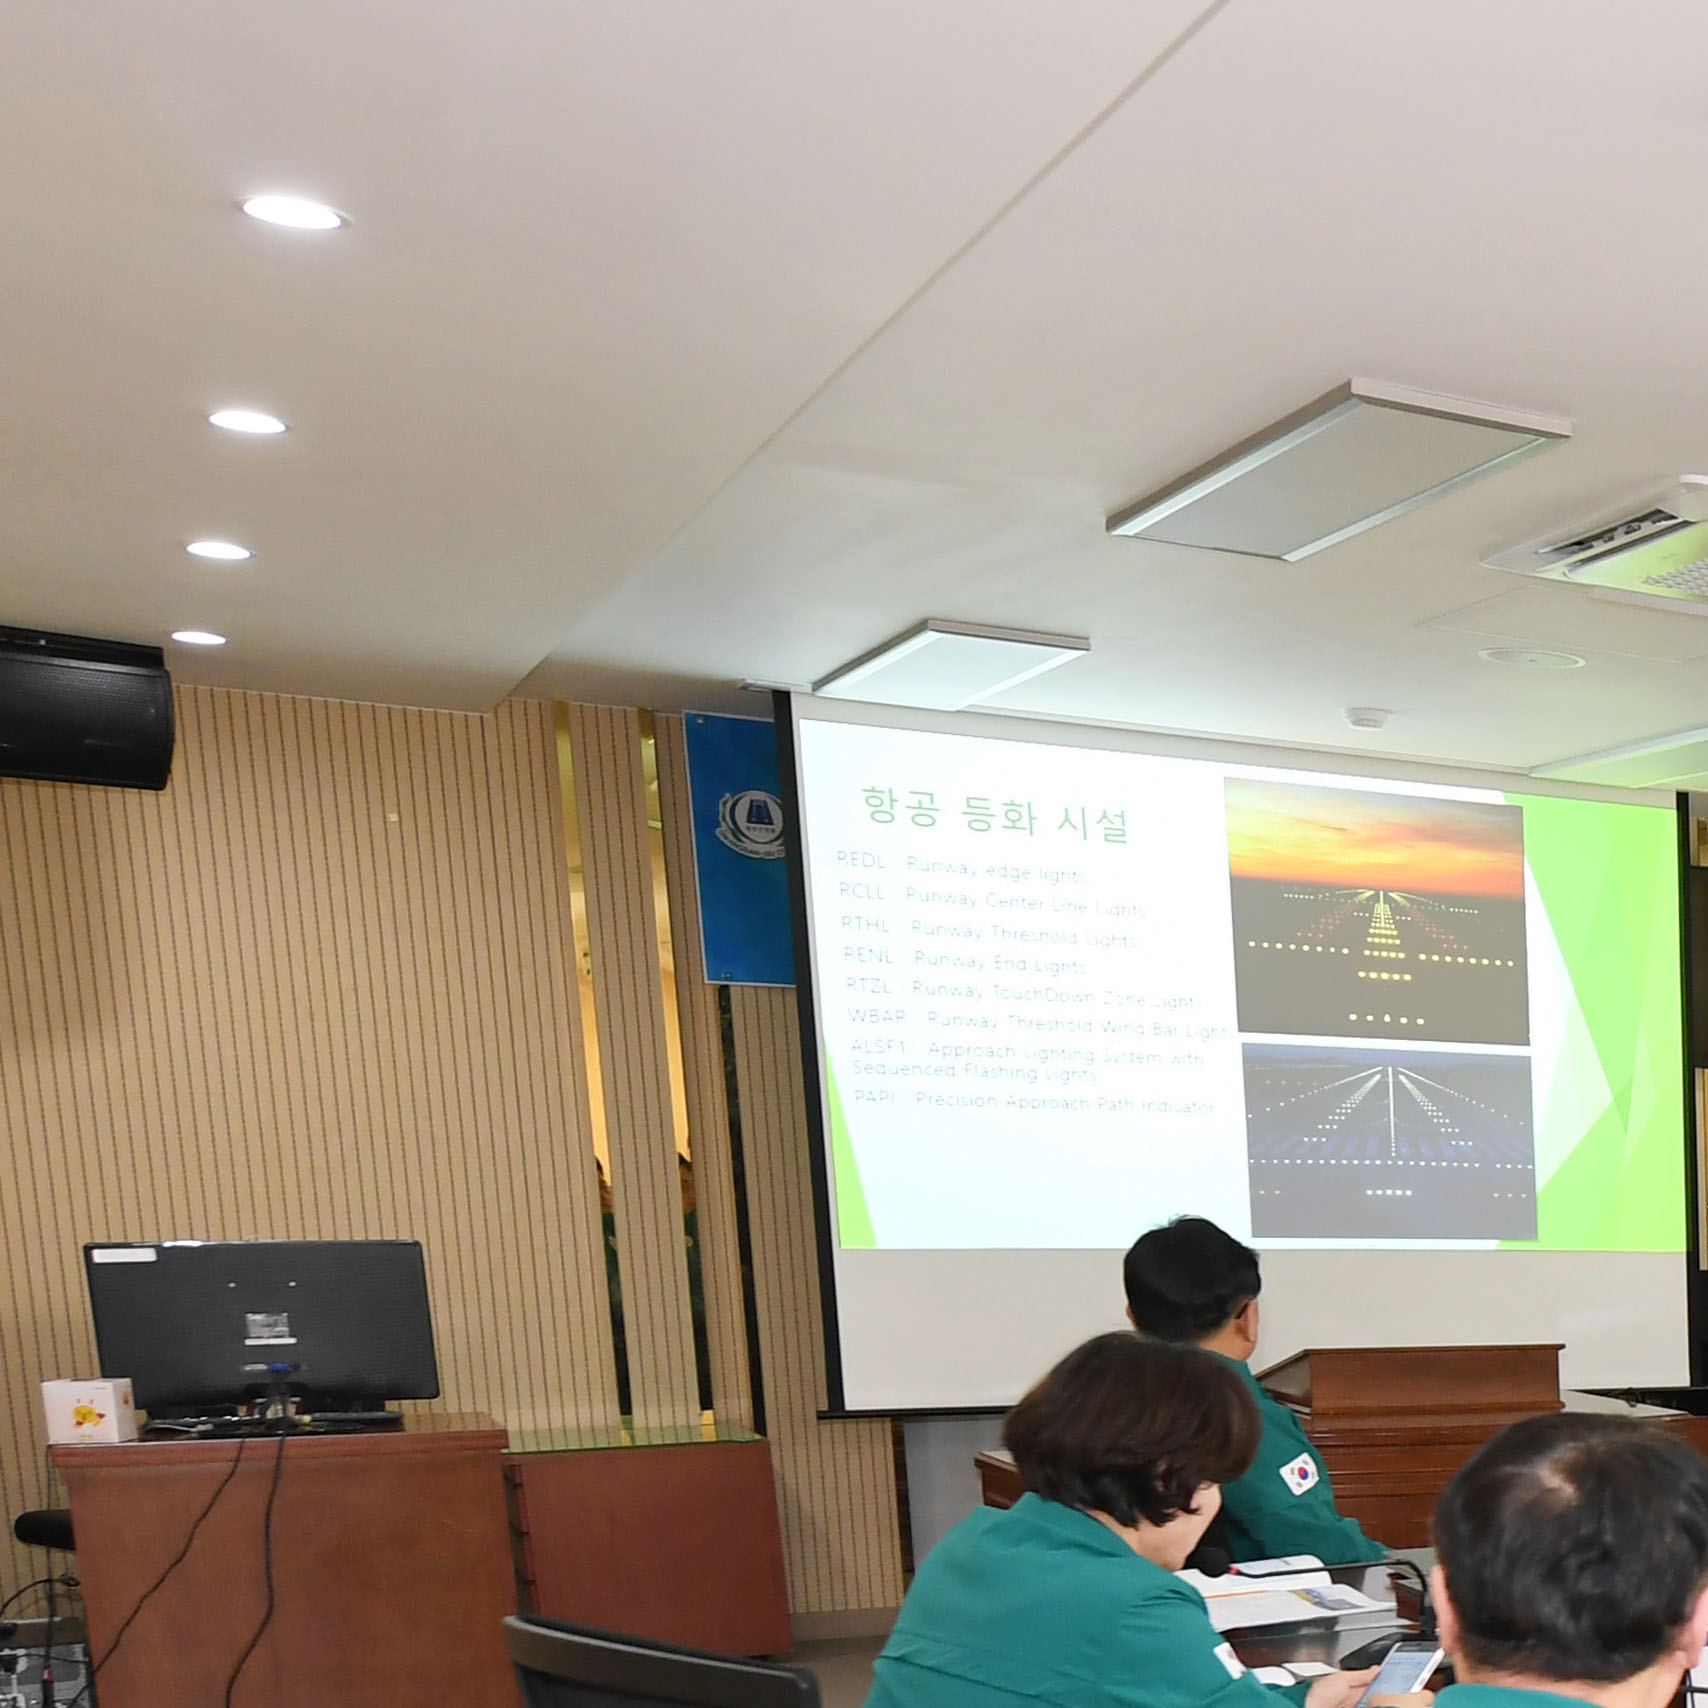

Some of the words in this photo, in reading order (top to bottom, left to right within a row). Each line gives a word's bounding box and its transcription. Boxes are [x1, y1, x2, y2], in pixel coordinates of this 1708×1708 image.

[862, 786, 940, 828] 항공
[962, 797, 1038, 836] 등화
[1057, 806, 1129, 845] 시설
[837, 851, 886, 869] REDL
[907, 856, 976, 879] Runway
[986, 865, 1031, 882] edge
[840, 882, 886, 900] RCLL
[907, 887, 976, 908] Runway
[986, 893, 1044, 910] Center
[842, 916, 889, 933] RTHL
[912, 920, 982, 940] Runway
[991, 925, 1077, 944] Threshold
[845, 947, 896, 964] RENL
[914, 950, 986, 971] Runway
[994, 955, 1026, 971] End
[1035, 960, 1088, 977] Lights
[847, 977, 892, 994] RTZL
[912, 981, 983, 1000] Runway
[992, 984, 1093, 1003] TouchDown
[1103, 991, 1145, 1007] Zone
[847, 1009, 908, 1026] WBAR
[927, 1012, 998, 1032] Runway
[1008, 1015, 1092, 1033] Threshold
[1103, 1019, 1145, 1039] Wing
[1153, 1022, 1178, 1037] Bar
[928, 1042, 1015, 1061] Approach
[1024, 1047, 1094, 1065] Lighting
[1103, 1047, 1162, 1065] System
[852, 1060, 956, 1079] Sequenced
[964, 1063, 1038, 1084] Flashing
[855, 1089, 895, 1105] PAPI
[915, 1091, 997, 1109] Precision
[1006, 1094, 1091, 1114] Approach
[1098, 1096, 1134, 1113] Path
